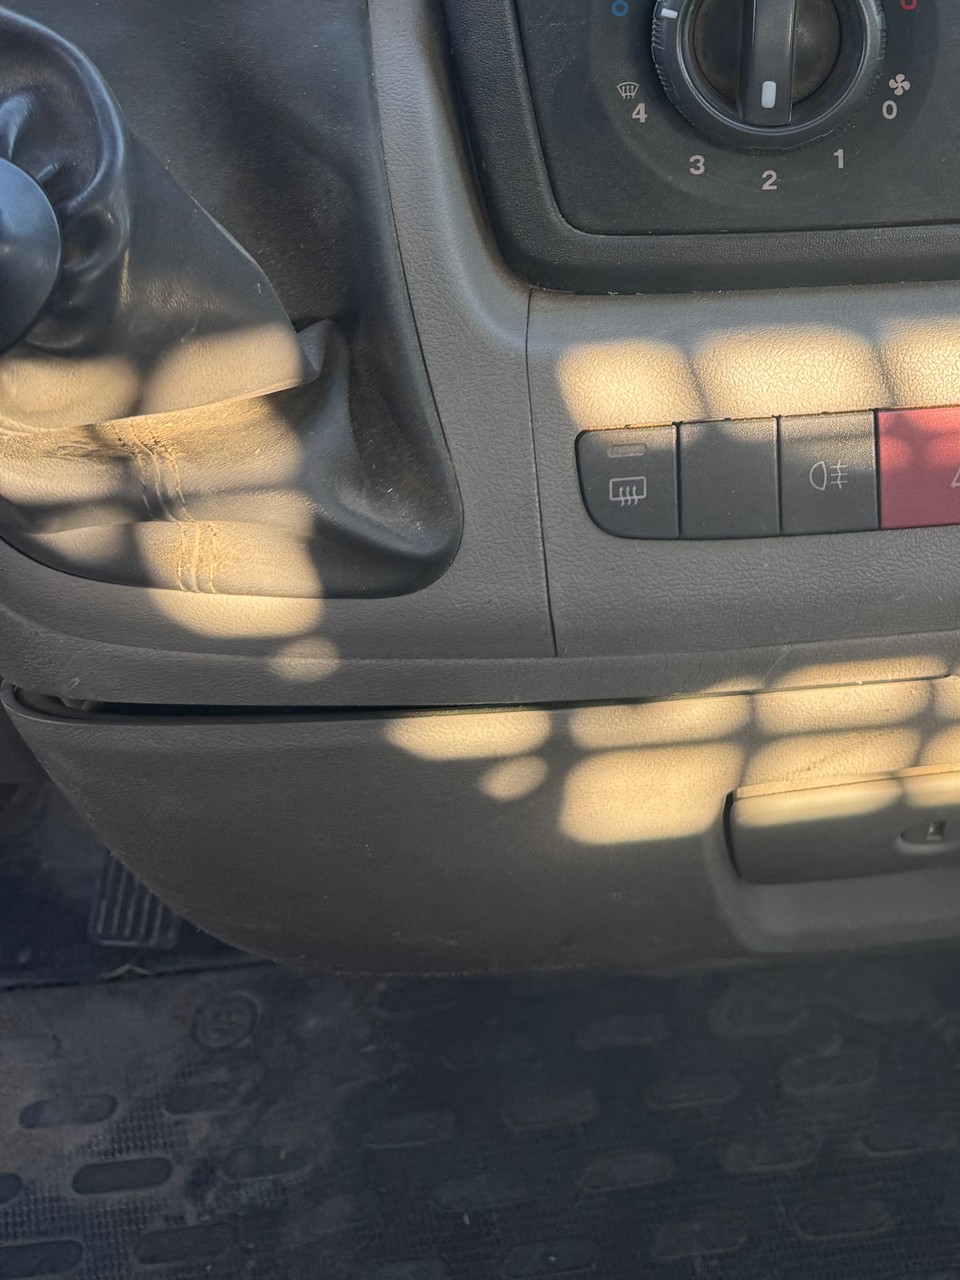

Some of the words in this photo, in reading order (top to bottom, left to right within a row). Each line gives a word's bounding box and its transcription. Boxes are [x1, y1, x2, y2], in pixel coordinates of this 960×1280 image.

[631, 103, 648, 123] 4
[882, 100, 898, 119] 0
[689, 155, 705, 175] 3
[833, 149, 844, 168] 1
[762, 171, 778, 190] 2
